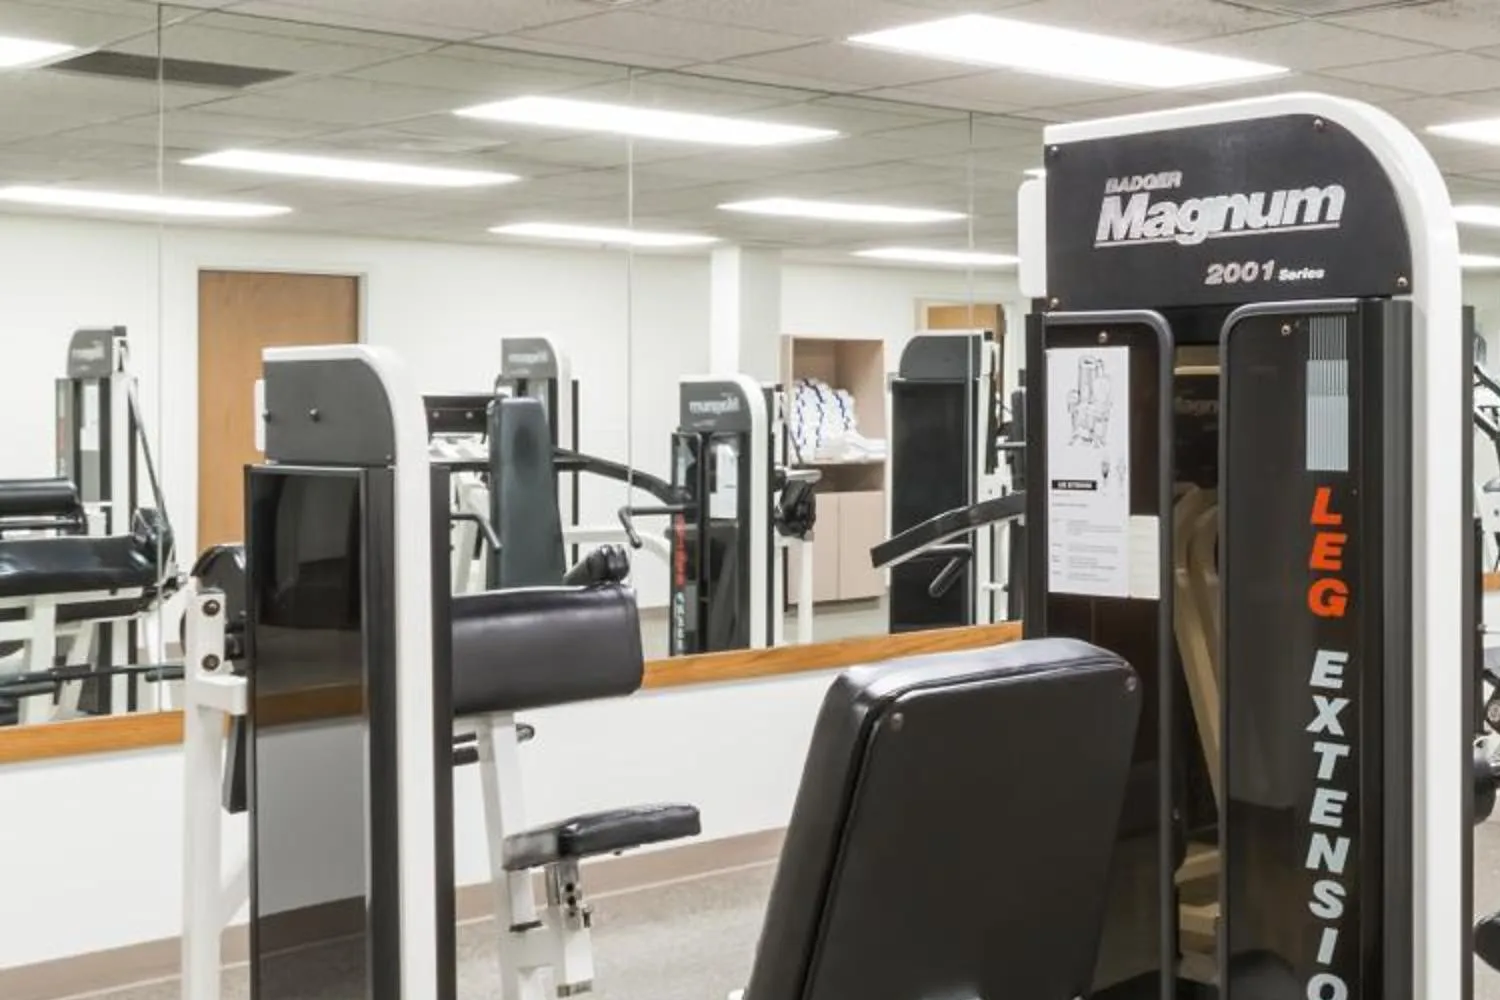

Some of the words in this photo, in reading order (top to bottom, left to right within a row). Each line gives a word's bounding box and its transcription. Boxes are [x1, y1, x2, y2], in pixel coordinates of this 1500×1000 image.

[1104, 170, 1183, 193] BADGER
[1095, 184, 1346, 245] Magnum
[1204, 260, 1275, 285] 2001
[1278, 267, 1325, 281] Series
[1307, 487, 1349, 618] LEG
